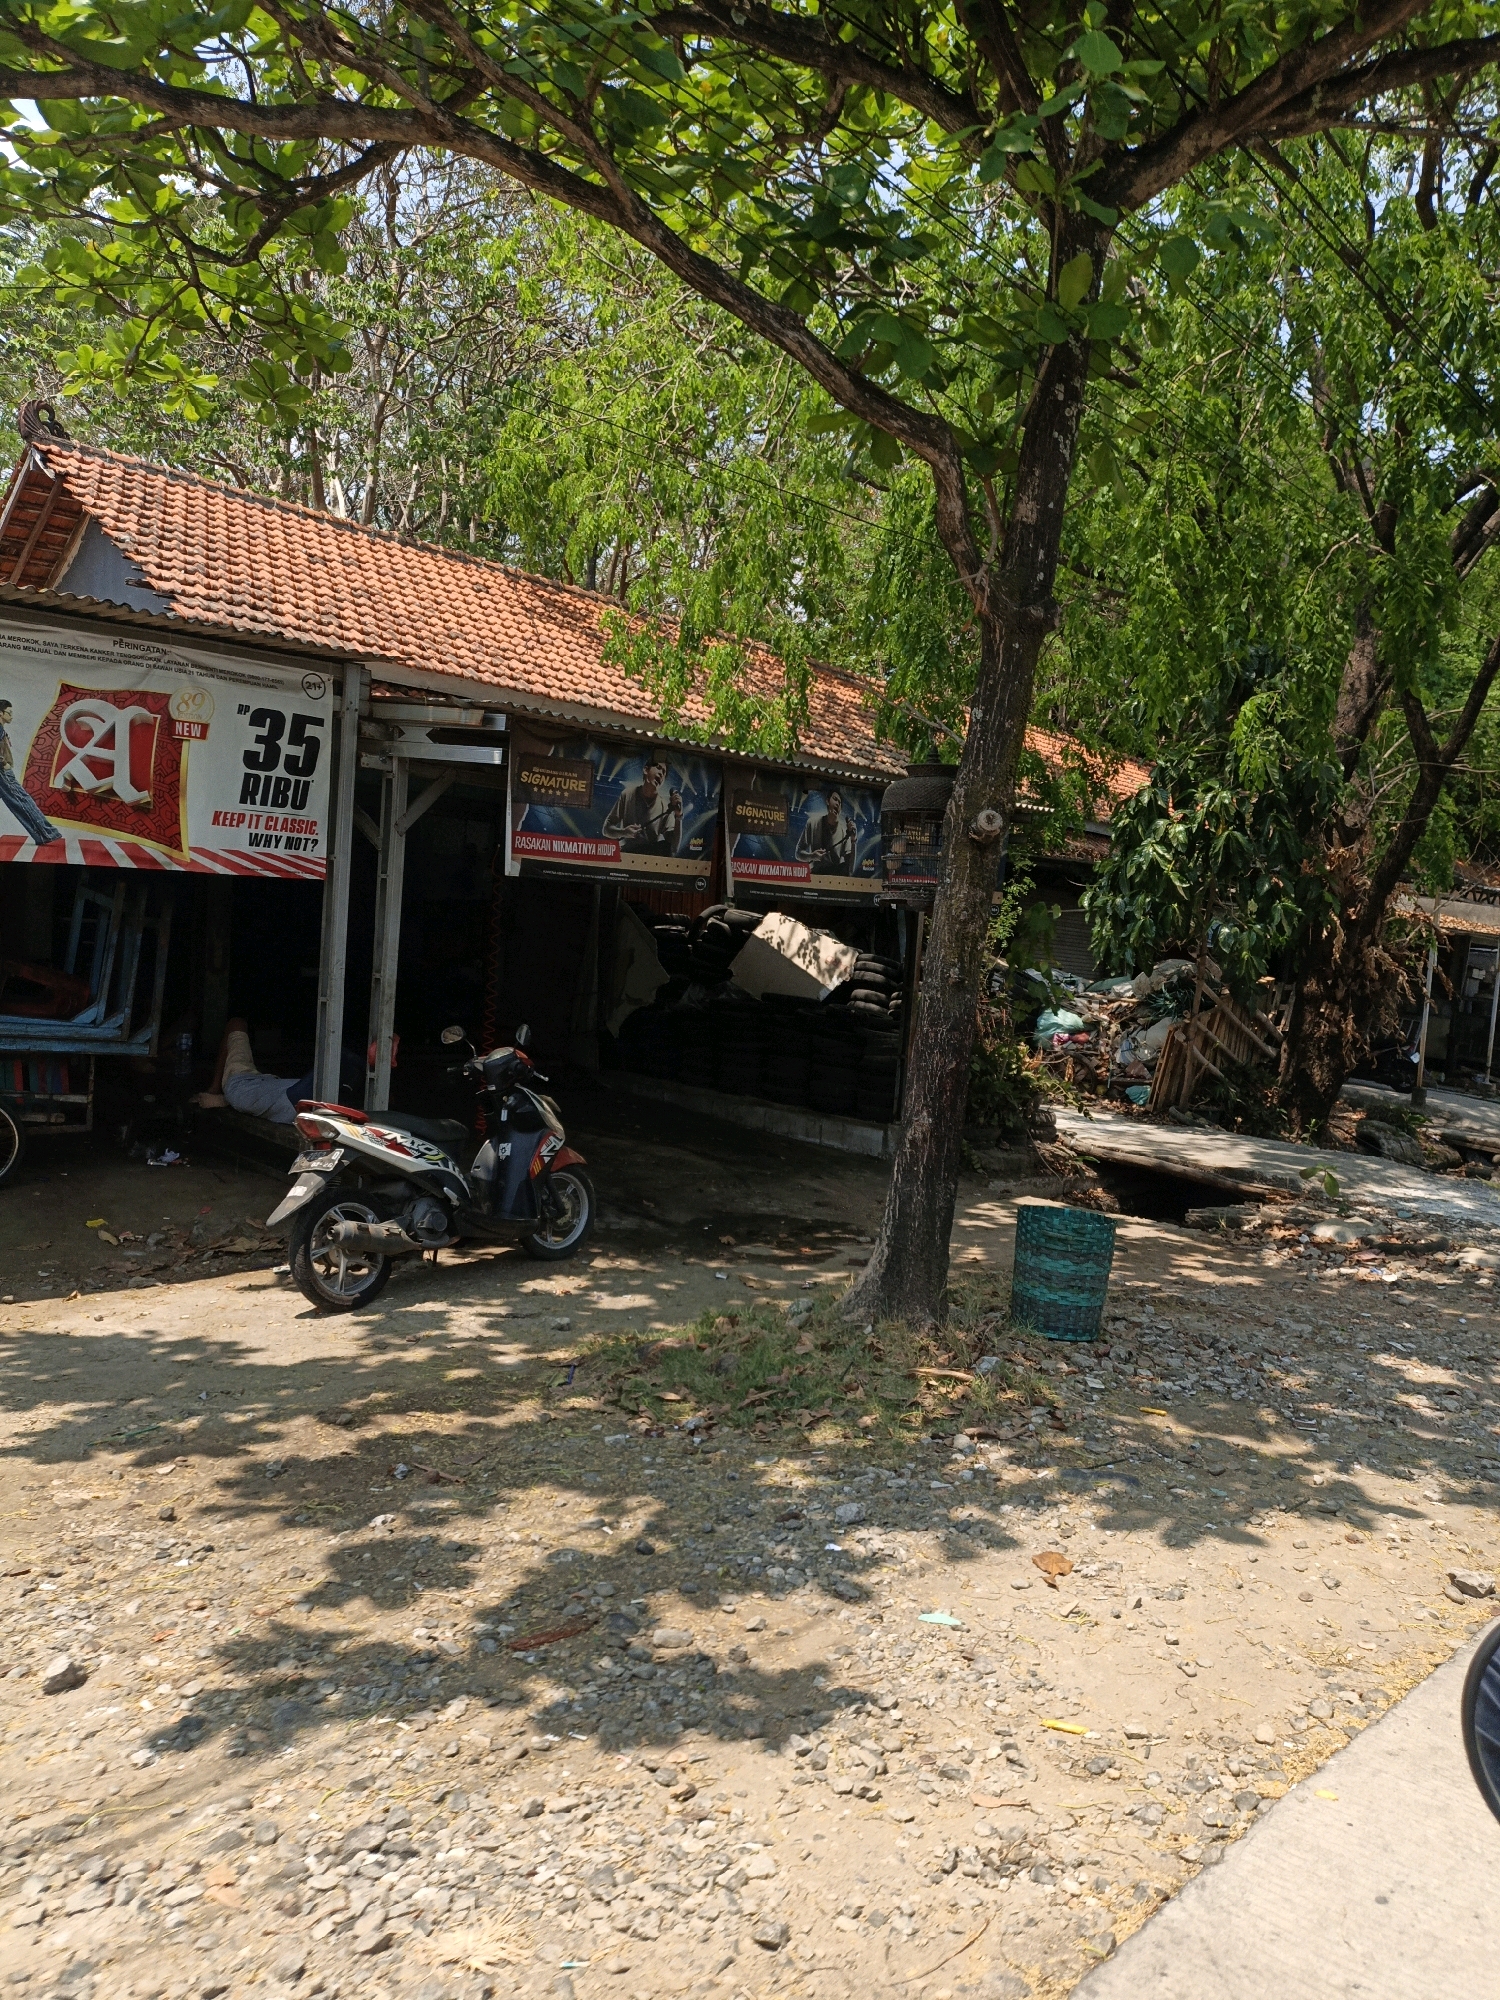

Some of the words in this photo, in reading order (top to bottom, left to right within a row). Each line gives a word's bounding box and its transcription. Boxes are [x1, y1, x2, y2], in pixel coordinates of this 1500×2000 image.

[22, 645, 52, 655] MENJUAL
[97, 656, 122, 665] KEPADA
[123, 660, 145, 668] ORANG
[152, 664, 173, 672] BAWAH
[196, 671, 215, 679] TAHUN
[42, 640, 59, 648] SAYA
[60, 643, 89, 652] TERKENA
[89, 648, 115, 657] KANKER
[163, 659, 190, 668] LAYANAN
[305, 681, 322, 691] 21+
[176, 692, 206, 713] 89
[236, 703, 250, 716] RP
[175, 721, 202, 737] NEW
[242, 707, 325, 778] 35
[520, 770, 587, 792] SIGNATURE
[211, 810, 246, 829] KEEP
[248, 813, 263, 830] IT
[264, 815, 319, 836] CLASSIC.
[735, 804, 785, 822] SIGNATURE
[248, 832, 283, 849] WHY
[284, 836, 319, 852] NOT?
[514, 835, 551, 852] RASAKAN
[552, 839, 596, 856] NIKMATNYA
[596, 843, 616, 857] HIDUP
[758, 864, 793, 877] NIKMATNYA
[792, 866, 808, 878] HIDUP
